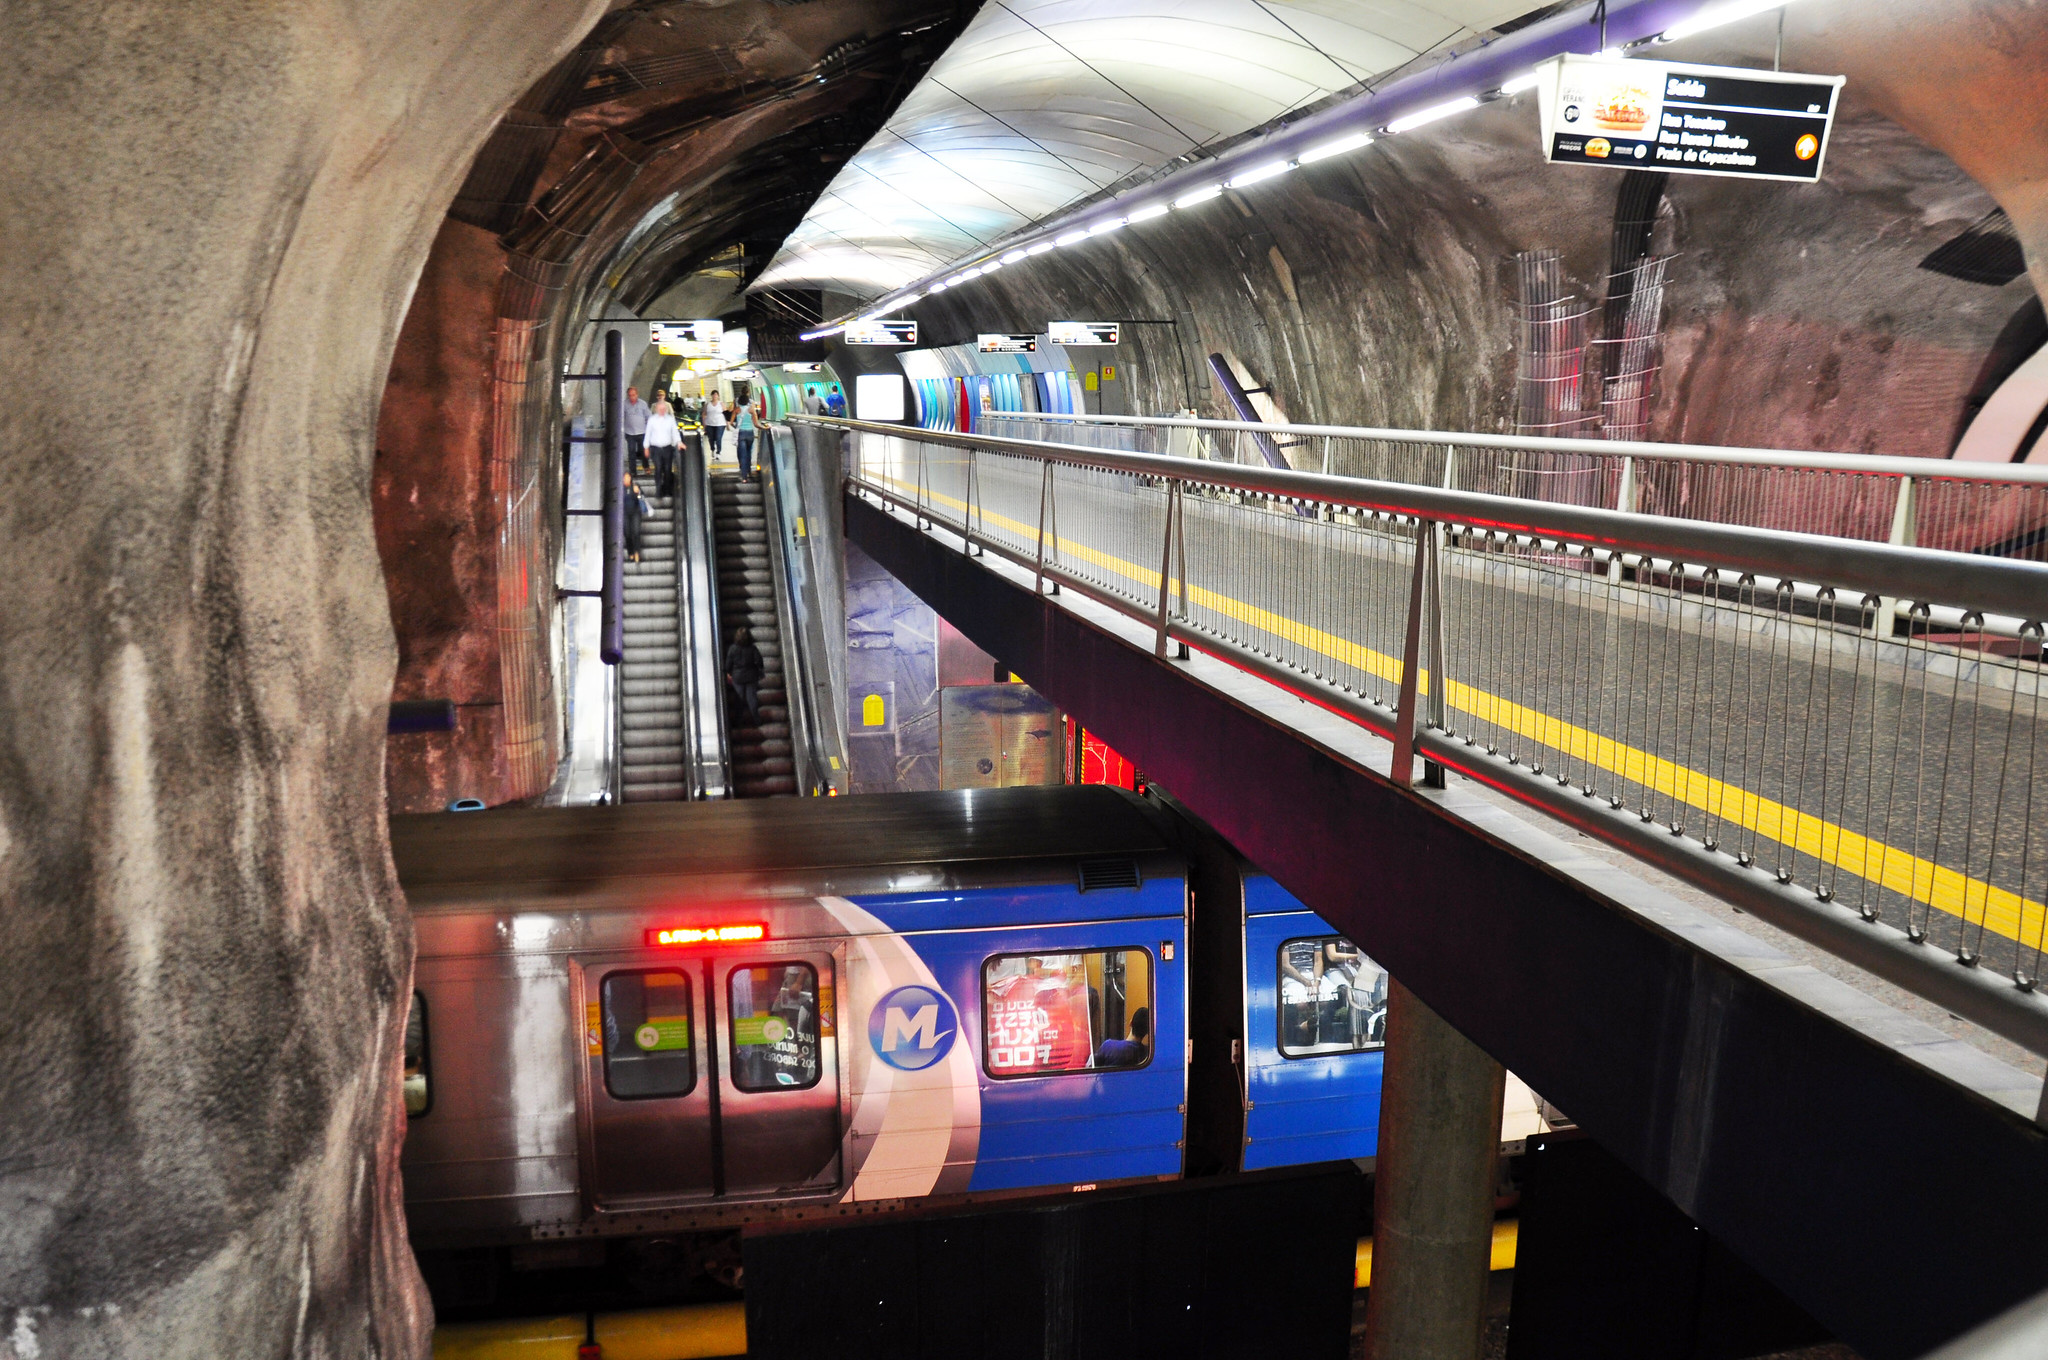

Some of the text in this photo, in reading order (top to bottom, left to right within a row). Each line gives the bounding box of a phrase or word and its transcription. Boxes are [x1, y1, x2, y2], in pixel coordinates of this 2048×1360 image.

[1666, 78, 1706, 97] Saída
[1662, 113, 1682, 127] Rua
[1659, 130, 1679, 144] Rua
[1657, 147, 1756, 165] Praia de Copacabana
[881, 1004, 954, 1052] M
